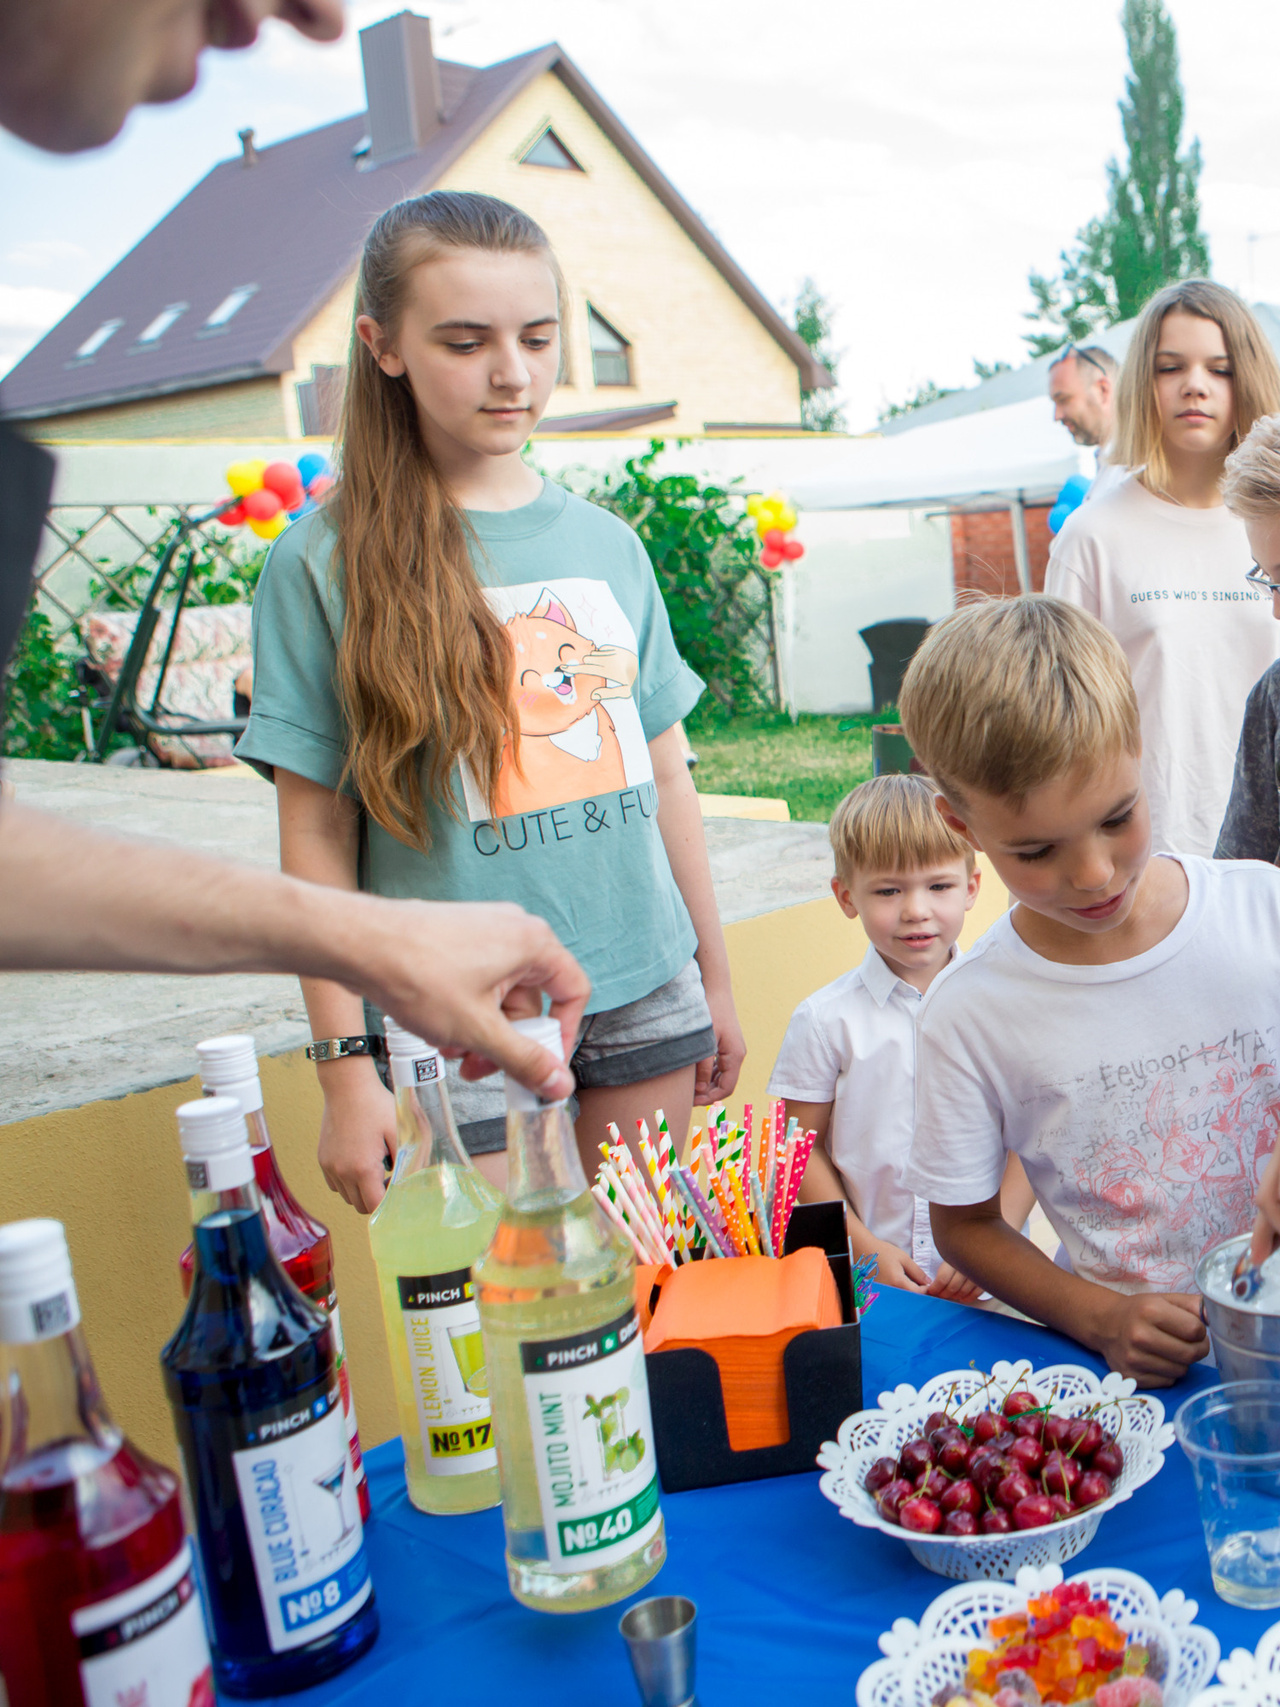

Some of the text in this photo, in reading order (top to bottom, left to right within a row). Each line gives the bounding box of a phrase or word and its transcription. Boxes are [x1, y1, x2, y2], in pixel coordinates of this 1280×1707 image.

[1131, 590, 1260, 603] GUESS WHO'S SINGING
[473, 807, 573, 857] CUTE
[583, 800, 611, 833] &
[417, 1287, 461, 1304] PINCH
[411, 1317, 442, 1420] LEMON JUICE
[547, 1341, 597, 1366] PINCH
[259, 1408, 311, 1440] PINCH
[539, 1392, 576, 1508] MOJITO MINT
[252, 1459, 298, 1584] BLUE CURACAO
